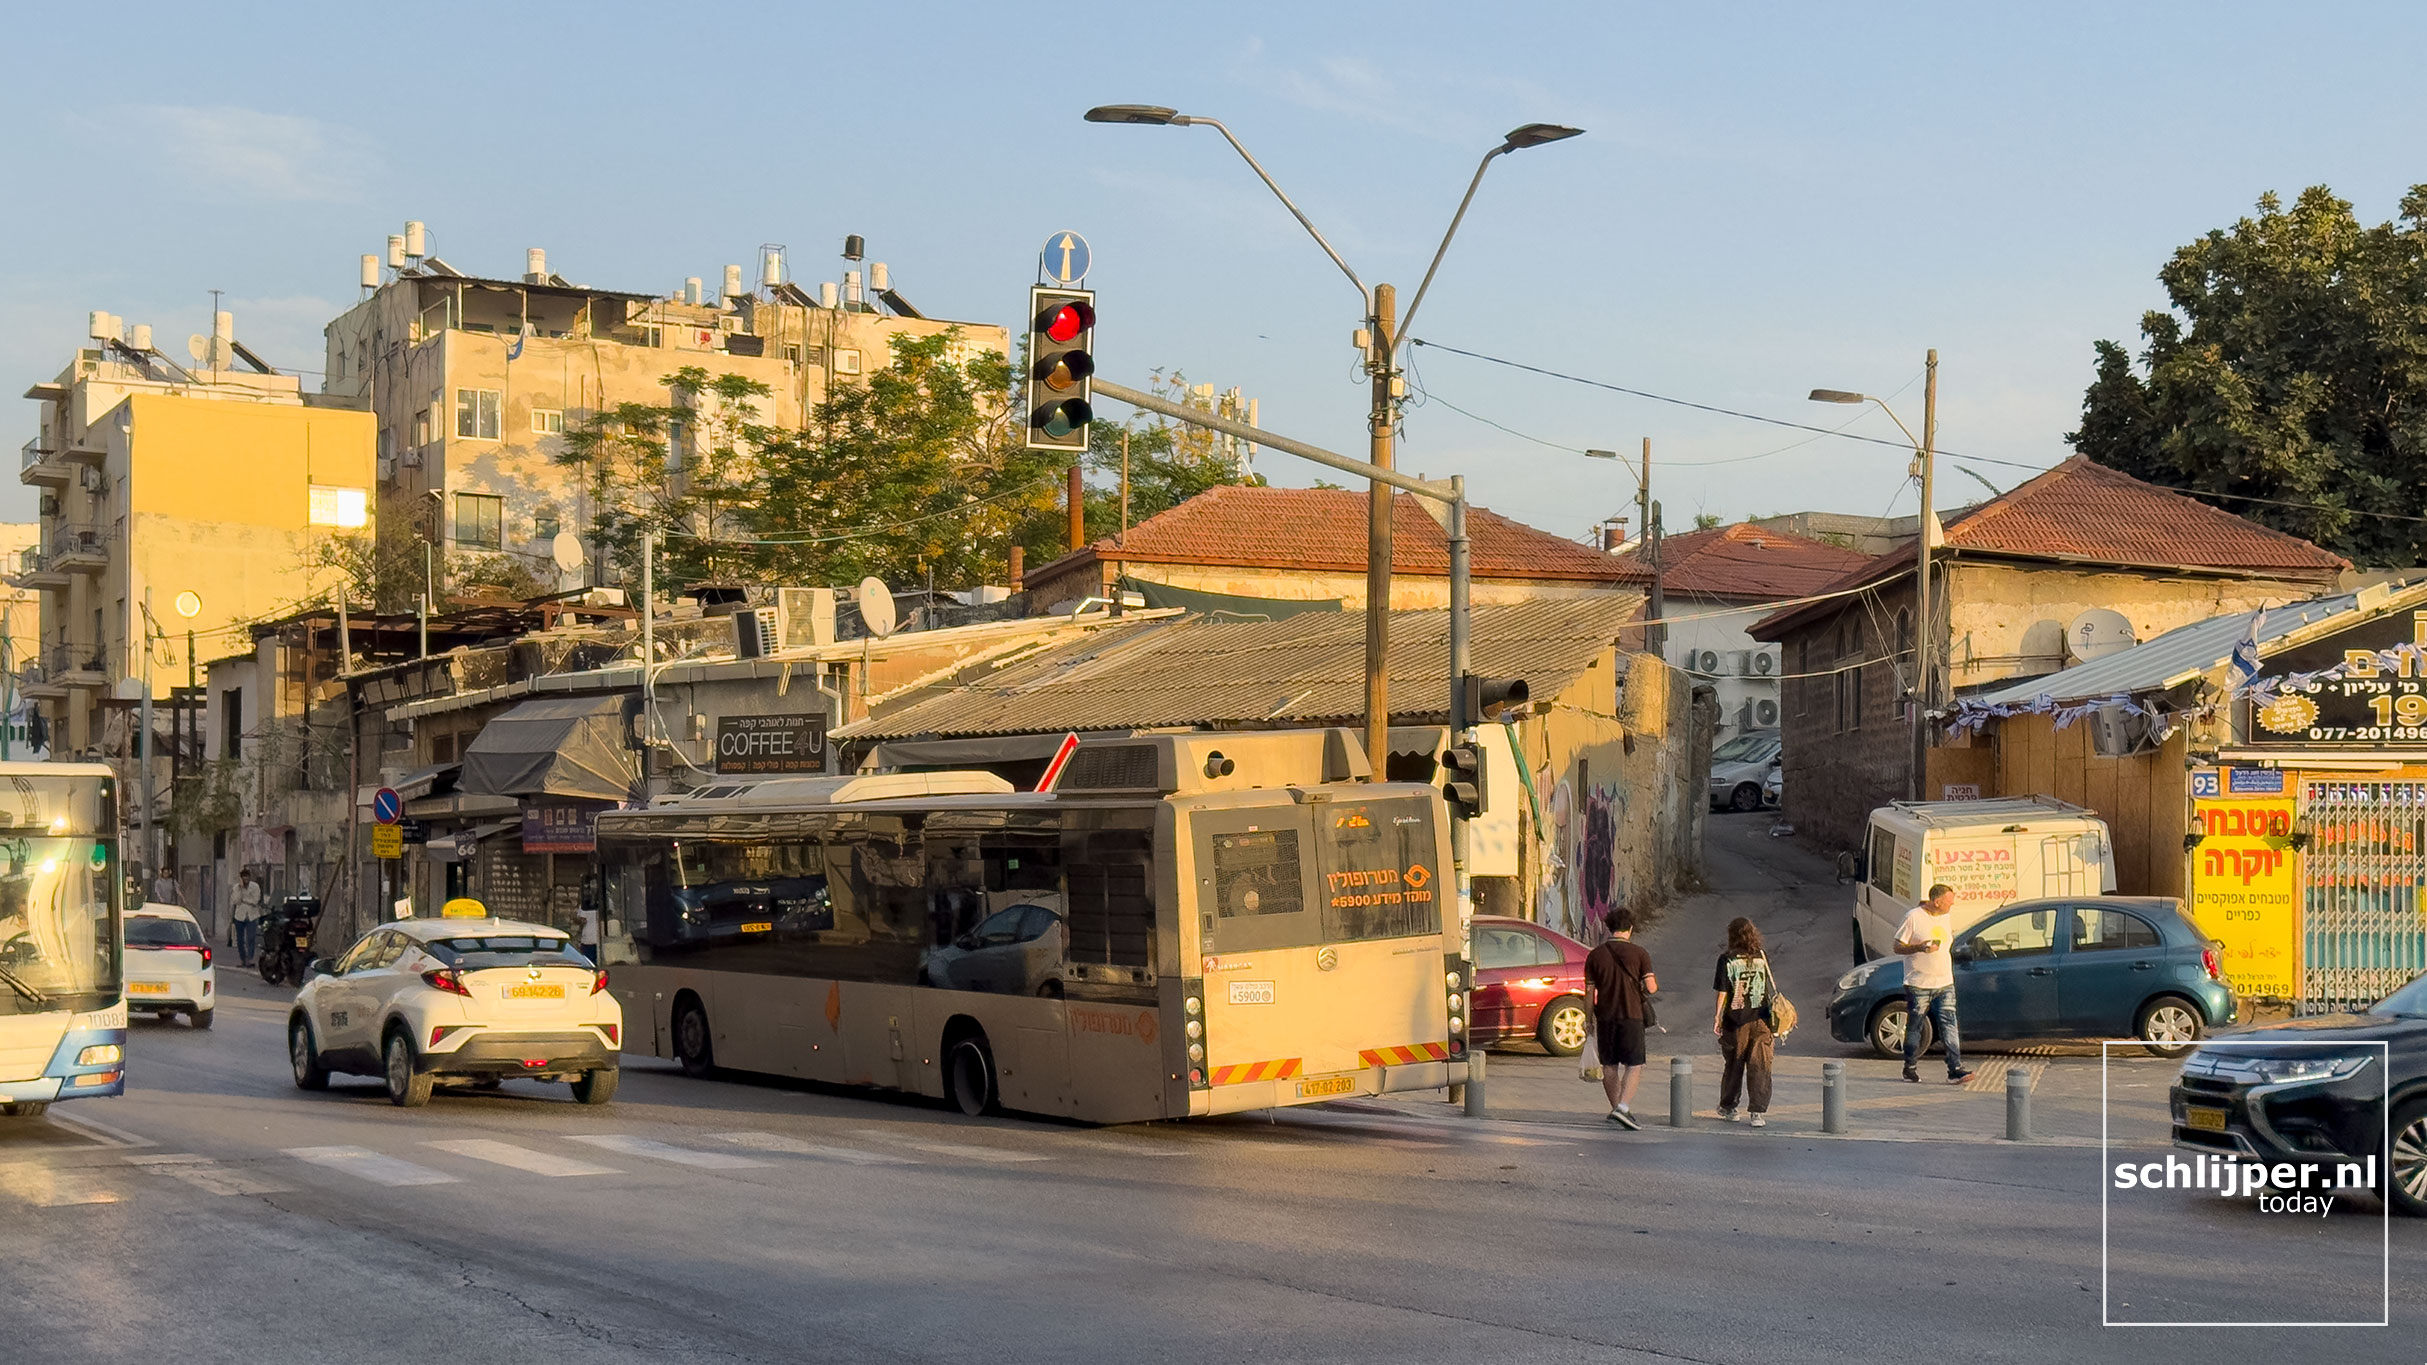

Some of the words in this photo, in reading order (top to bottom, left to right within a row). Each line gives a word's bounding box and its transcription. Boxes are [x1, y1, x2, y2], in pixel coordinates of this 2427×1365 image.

[2343, 680, 2391, 697] עליון
[740, 719, 757, 730] קפה
[1951, 786, 1973, 794] חניה
[2194, 776, 2219, 794] 93
[457, 843, 476, 856] 66
[1975, 863, 1980, 871] 2
[2205, 849, 2282, 886] יוקרה
[1327, 869, 1399, 893] מטרופולין
[1373, 892, 1402, 905] מידע
[1403, 890, 1432, 903] מוקד
[2197, 893, 2246, 907] אפוקסיים
[2249, 893, 2290, 904] מטבחים
[2226, 910, 2261, 921] כפריים
[2237, 983, 2289, 994] 014969
